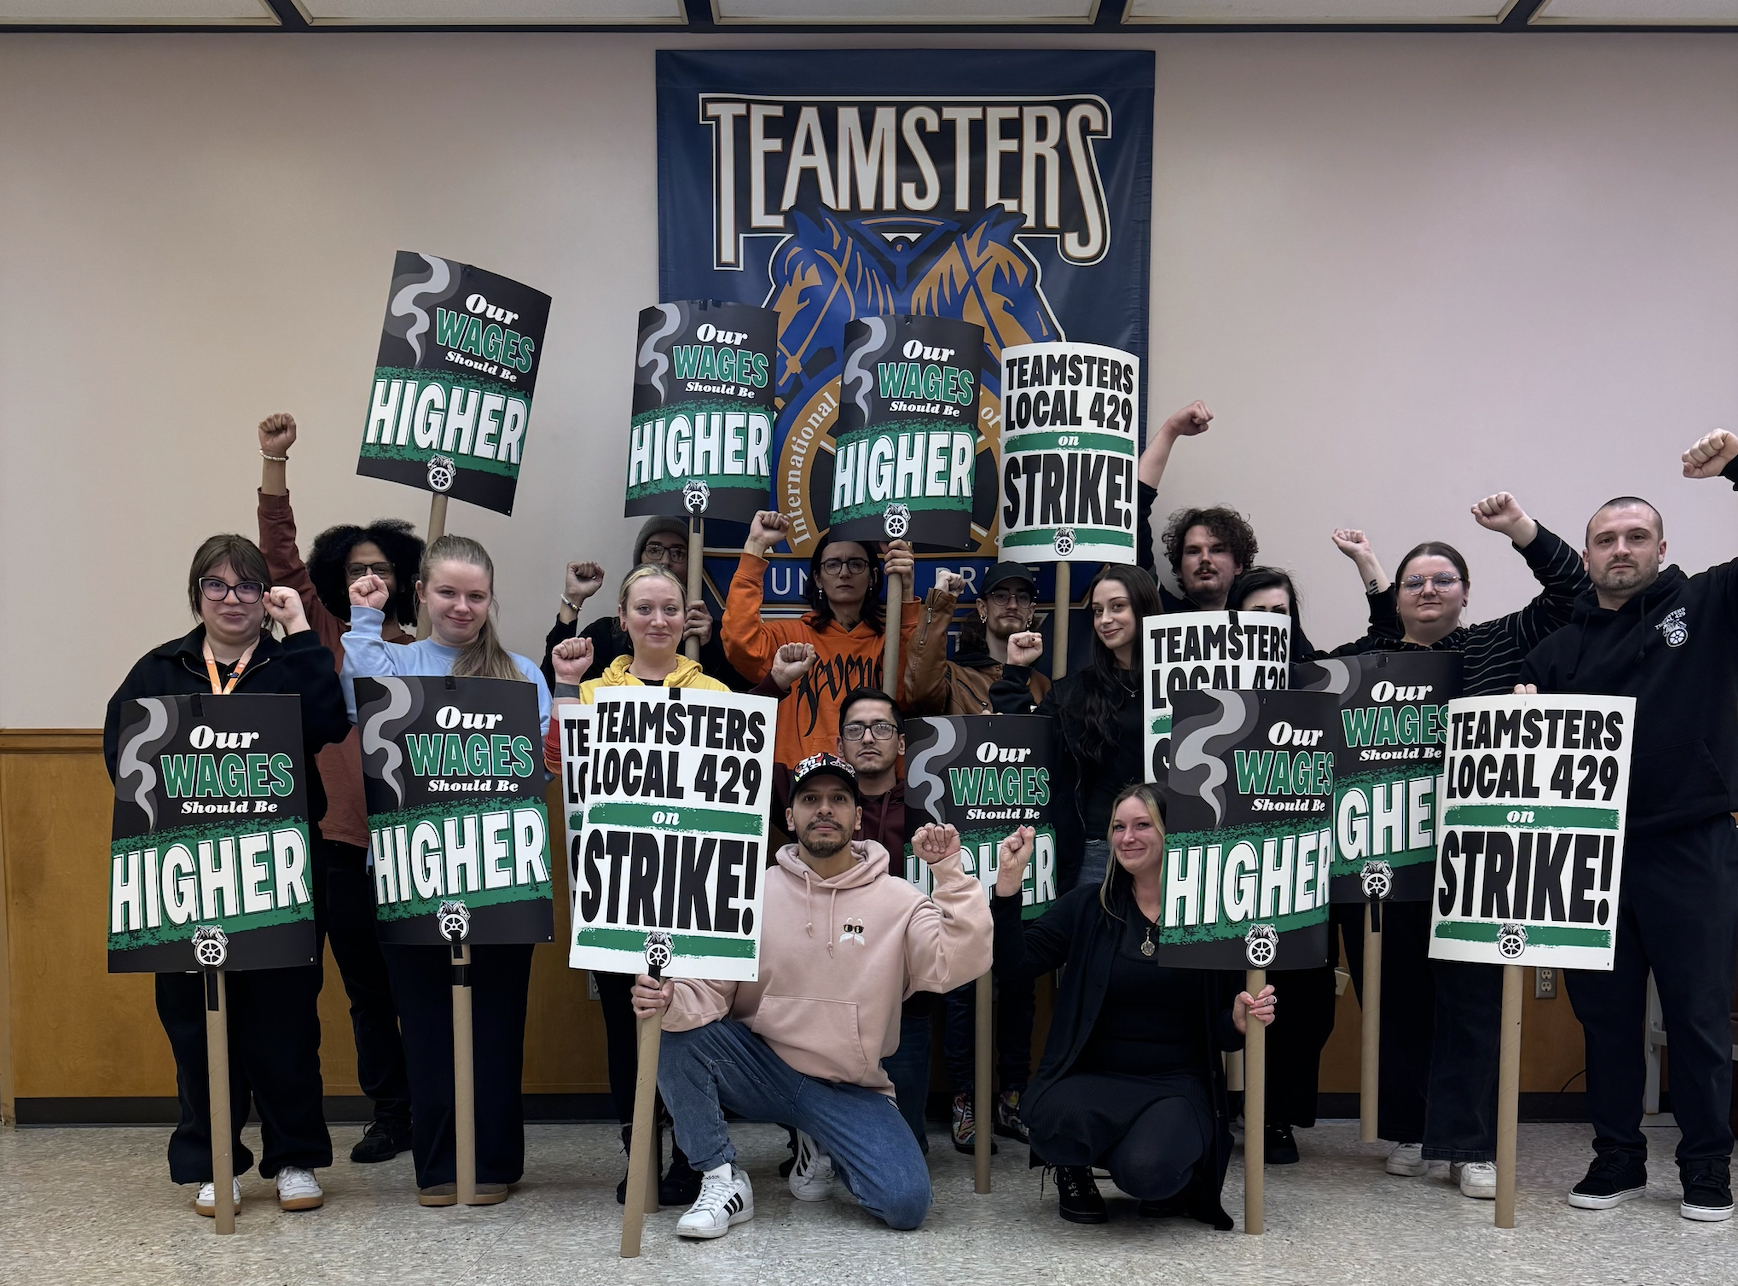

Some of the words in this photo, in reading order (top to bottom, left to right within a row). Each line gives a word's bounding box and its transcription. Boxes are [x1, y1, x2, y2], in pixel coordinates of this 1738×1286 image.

[705, 103, 1104, 263] TEAMSTERS
[465, 293, 518, 325] Our
[436, 307, 535, 374] WAGES
[696, 323, 748, 345] Our
[902, 339, 955, 362] Our
[445, 350, 497, 377] Should
[499, 367, 517, 383] Be
[672, 345, 769, 388] WAGES
[877, 362, 974, 406] WAGES
[1006, 354, 1133, 395] TEAMSTERS
[685, 381, 735, 395] Should
[737, 387, 755, 398] Be
[889, 400, 939, 414] Should
[942, 405, 960, 417] Be
[365, 378, 528, 466] HIGHER
[1005, 389, 1082, 431] LOCAL
[1089, 392, 1132, 433] 429
[629, 412, 771, 487] HIGHER
[1058, 435, 1079, 446] on
[787, 391, 838, 546] International
[833, 431, 974, 511] HIGHER
[1003, 452, 1133, 530] STRIKE!
[1150, 624, 1287, 664] TEAMSTERS
[1371, 680, 1433, 702] Our
[189, 725, 259, 749] Our
[435, 705, 503, 730] Our
[597, 701, 766, 754] TEAMSTERS
[1268, 721, 1323, 746] Our
[1451, 709, 1624, 751] TEAMSTERS
[405, 733, 535, 778] WAGES
[976, 741, 1031, 763] Our
[1359, 747, 1420, 761] Should
[1422, 747, 1442, 759] Be
[160, 752, 294, 798] WAGES
[428, 779, 492, 793] Should
[495, 779, 519, 792] Be
[591, 747, 684, 799] LOCAL
[694, 753, 762, 806] 429
[949, 766, 1050, 806] WAGES
[1234, 750, 1334, 796] WAGES
[1447, 753, 1540, 799] LOCAL
[1550, 754, 1619, 801] 429
[181, 800, 248, 814] Should
[253, 800, 278, 814] Be
[652, 810, 680, 826] on
[966, 808, 1021, 820] Should
[1023, 808, 1040, 820] Be
[1251, 798, 1308, 812] Should
[1312, 798, 1325, 811] Be
[1506, 810, 1535, 823] on
[369, 807, 551, 905] HIGHER
[111, 827, 311, 933] HIGHER
[581, 829, 759, 936] STRIKE!
[1165, 827, 1332, 928] HIGHER
[1438, 830, 1616, 926] STRIKE!
